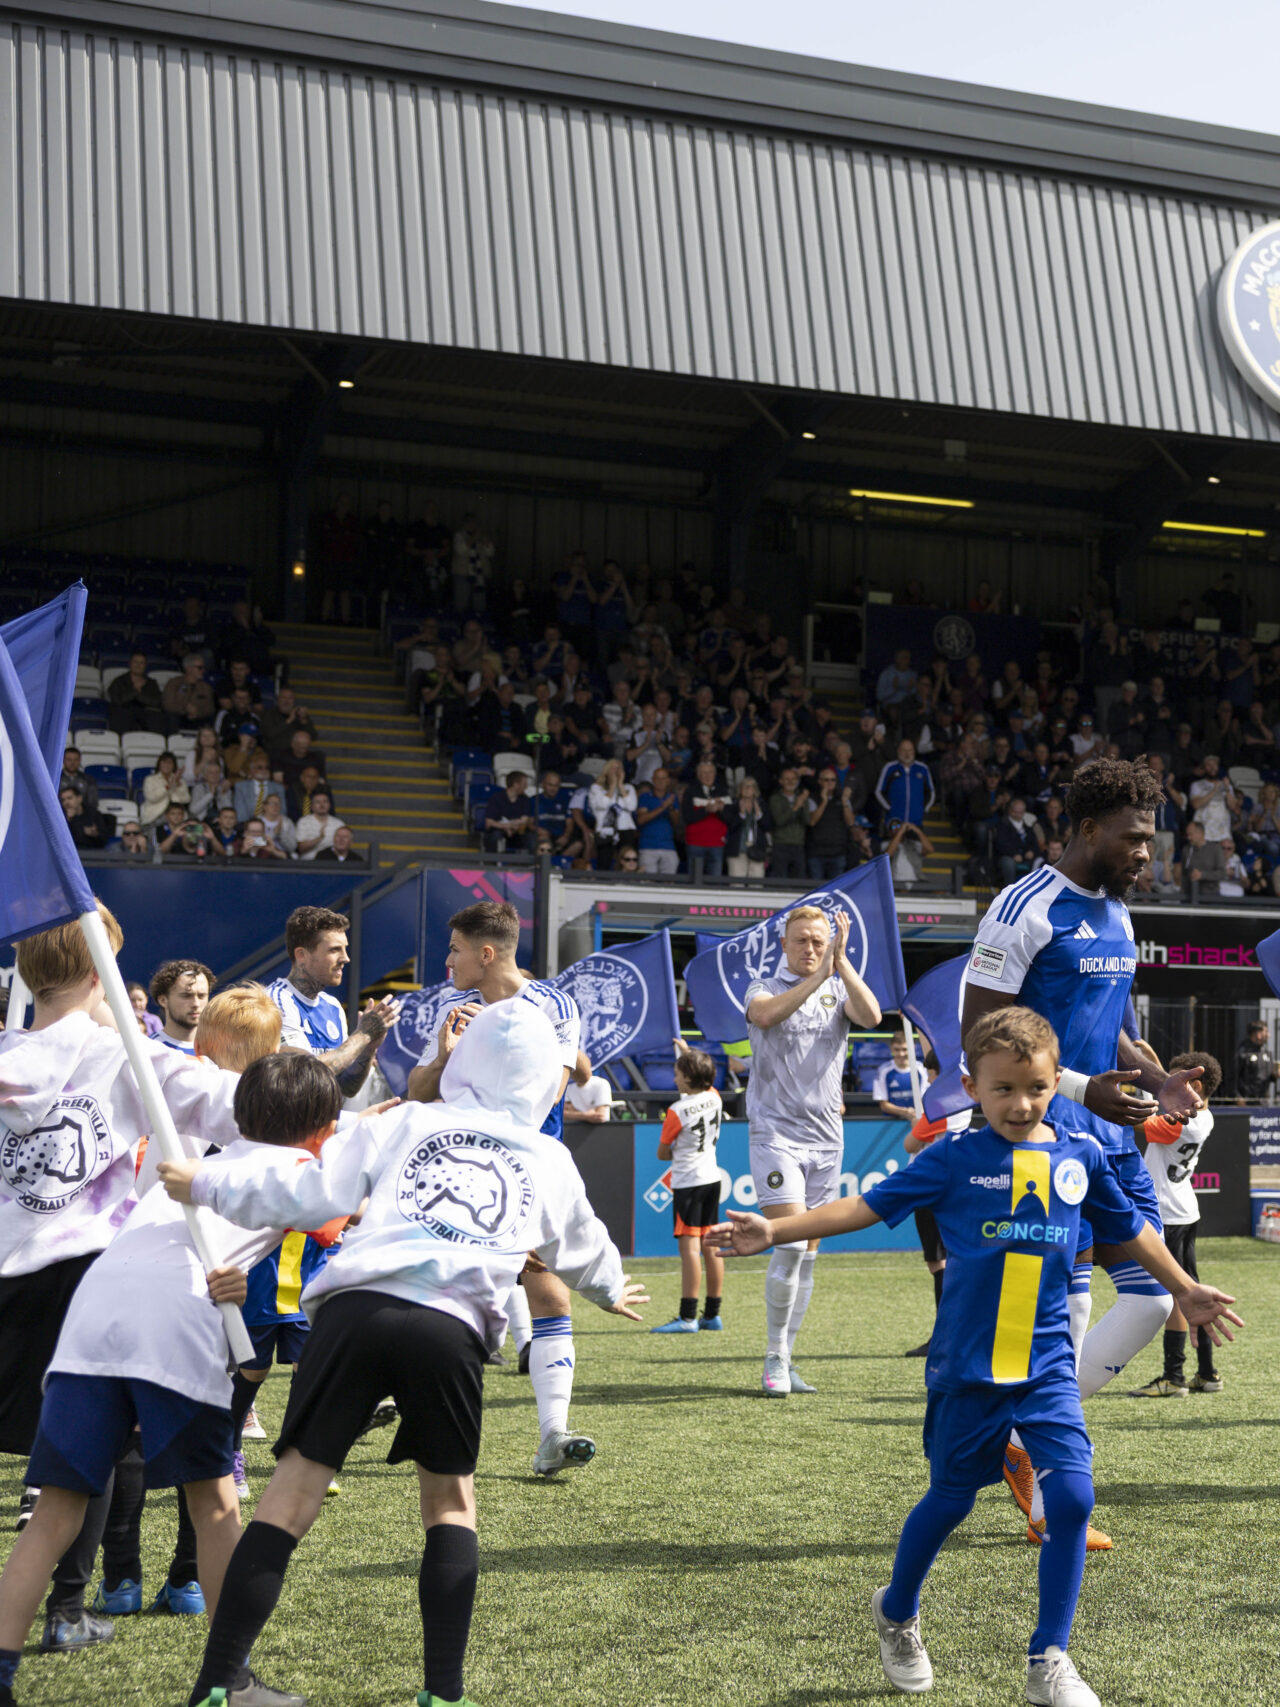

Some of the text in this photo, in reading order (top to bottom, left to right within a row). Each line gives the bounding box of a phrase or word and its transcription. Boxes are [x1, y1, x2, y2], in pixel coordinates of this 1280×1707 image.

[689, 905, 775, 918] MACCLESFIE
[907, 914, 941, 924] AWAY
[1136, 940, 1260, 967] thshack.
[1103, 957, 1120, 972] AND
[1259, 1130, 1272, 1141] for
[98, 1151, 110, 1161] 22
[404, 1132, 533, 1218] CHORLTON GREEN VILLA
[969, 1174, 1011, 1189] capelli
[18, 1191, 66, 1211] OTBALL
[400, 1190, 414, 1200] 20
[981, 1221, 1070, 1244] CONCEPT
